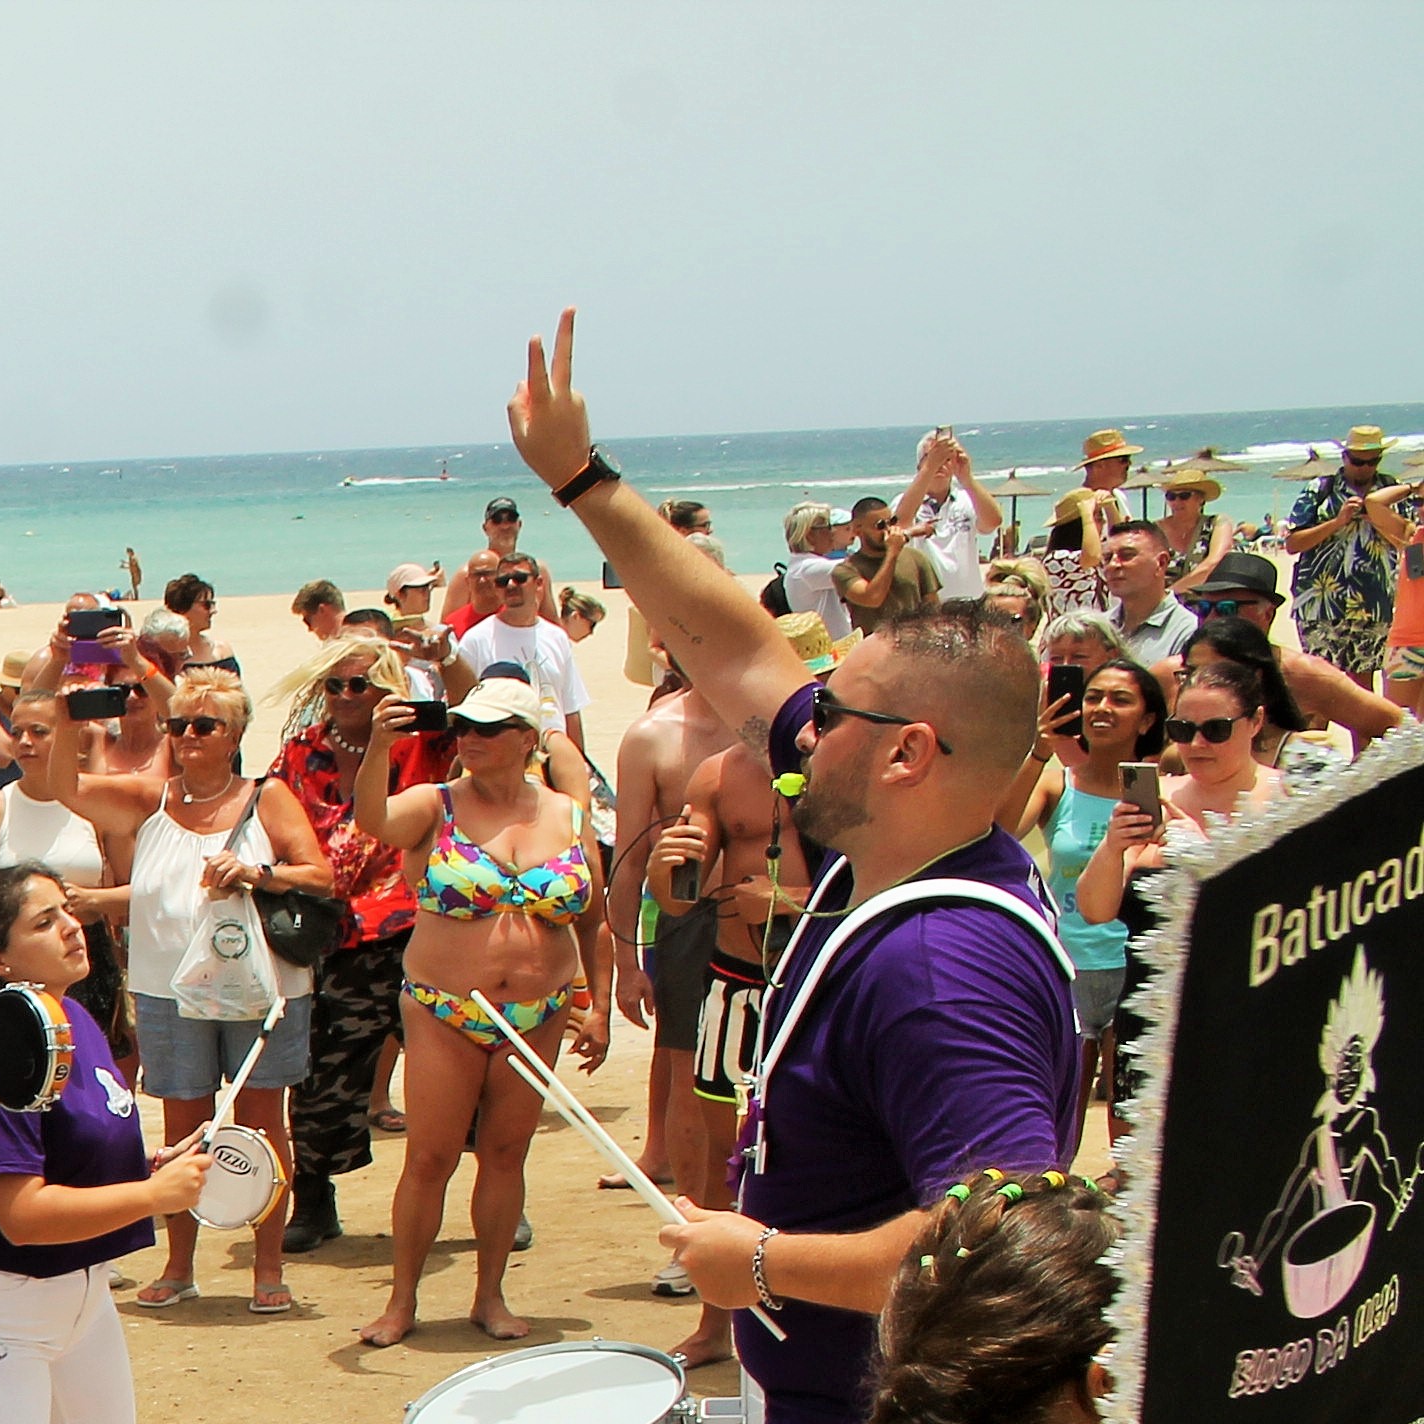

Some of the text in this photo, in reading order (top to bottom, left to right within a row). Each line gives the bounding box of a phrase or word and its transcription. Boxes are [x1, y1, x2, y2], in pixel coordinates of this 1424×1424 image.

[217, 1149, 249, 1171] IZZO
[1228, 1337, 1313, 1399] BLOCO
[1315, 1315, 1350, 1374] DA
